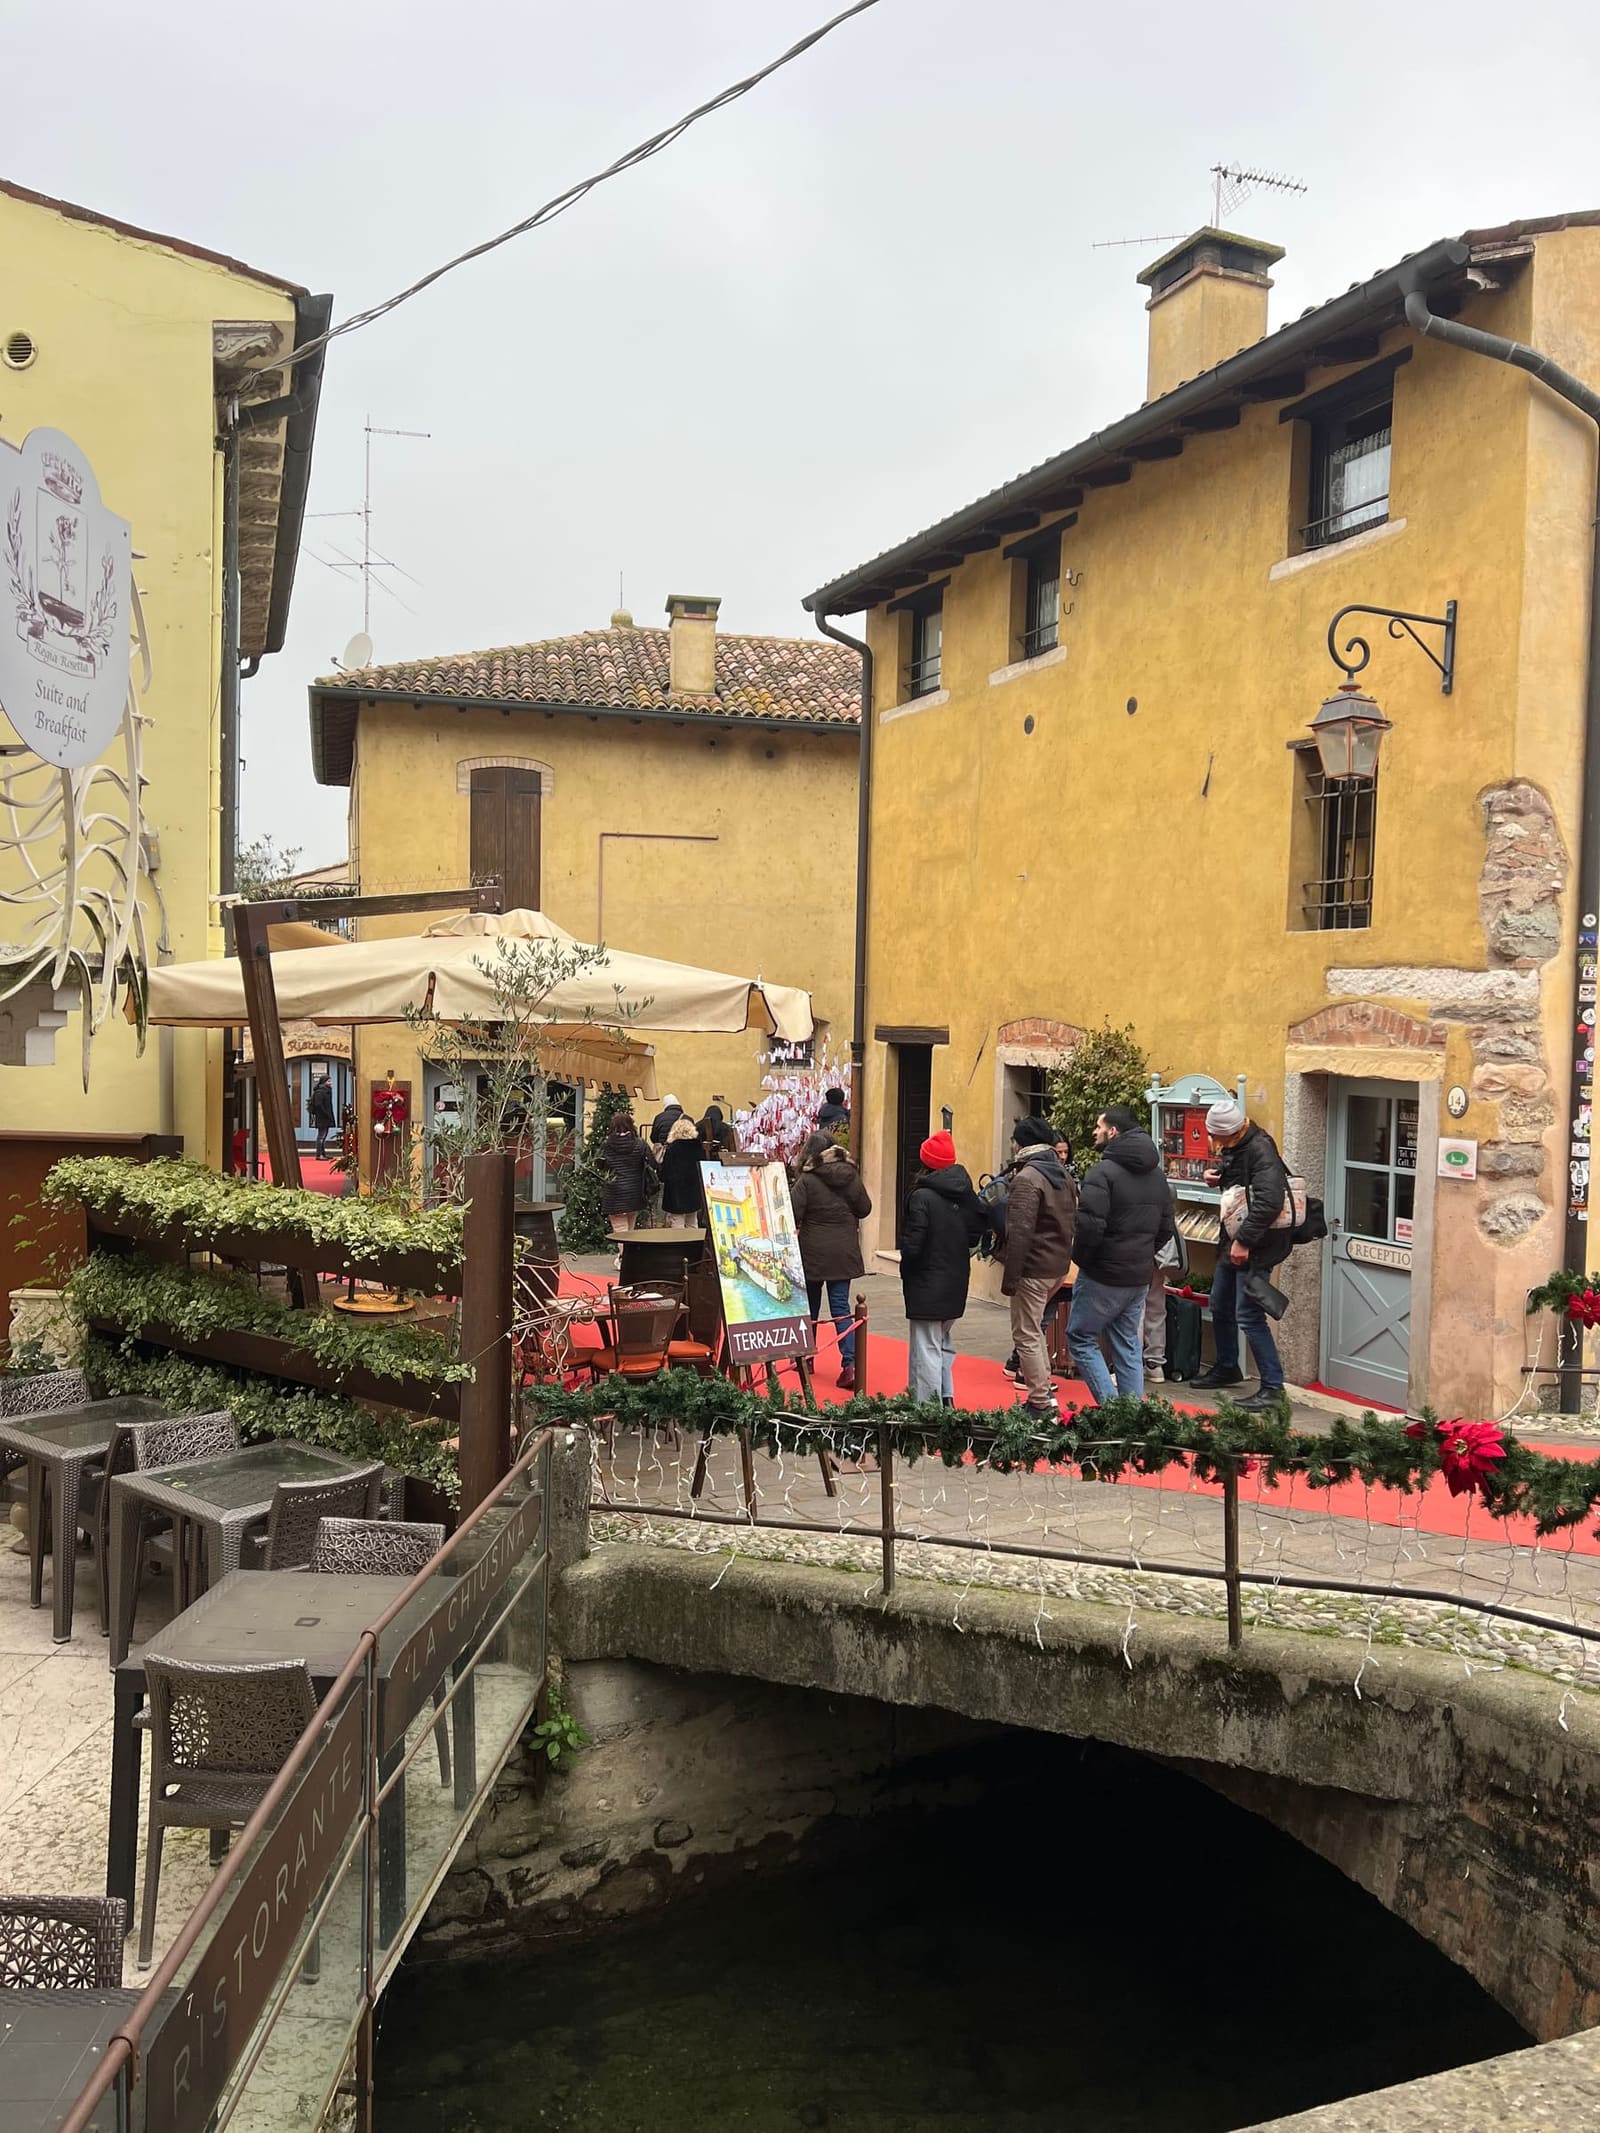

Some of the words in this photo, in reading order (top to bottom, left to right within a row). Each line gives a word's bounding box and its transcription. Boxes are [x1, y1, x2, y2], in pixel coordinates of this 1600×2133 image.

[60, 655, 89, 673] Rosetta
[35, 679, 64, 705] Suite
[66, 692, 90, 714] and
[34, 710, 87, 747] Breakfast
[287, 1039, 351, 1054] Ristorante
[1354, 1243, 1412, 1266] RECEPTIO
[733, 1326, 799, 1352] TERRAZZA
[412, 1626, 436, 1683] LA
[448, 1513, 526, 1632] CHIUSINA
[173, 1741, 352, 2118] RISTORANTE
